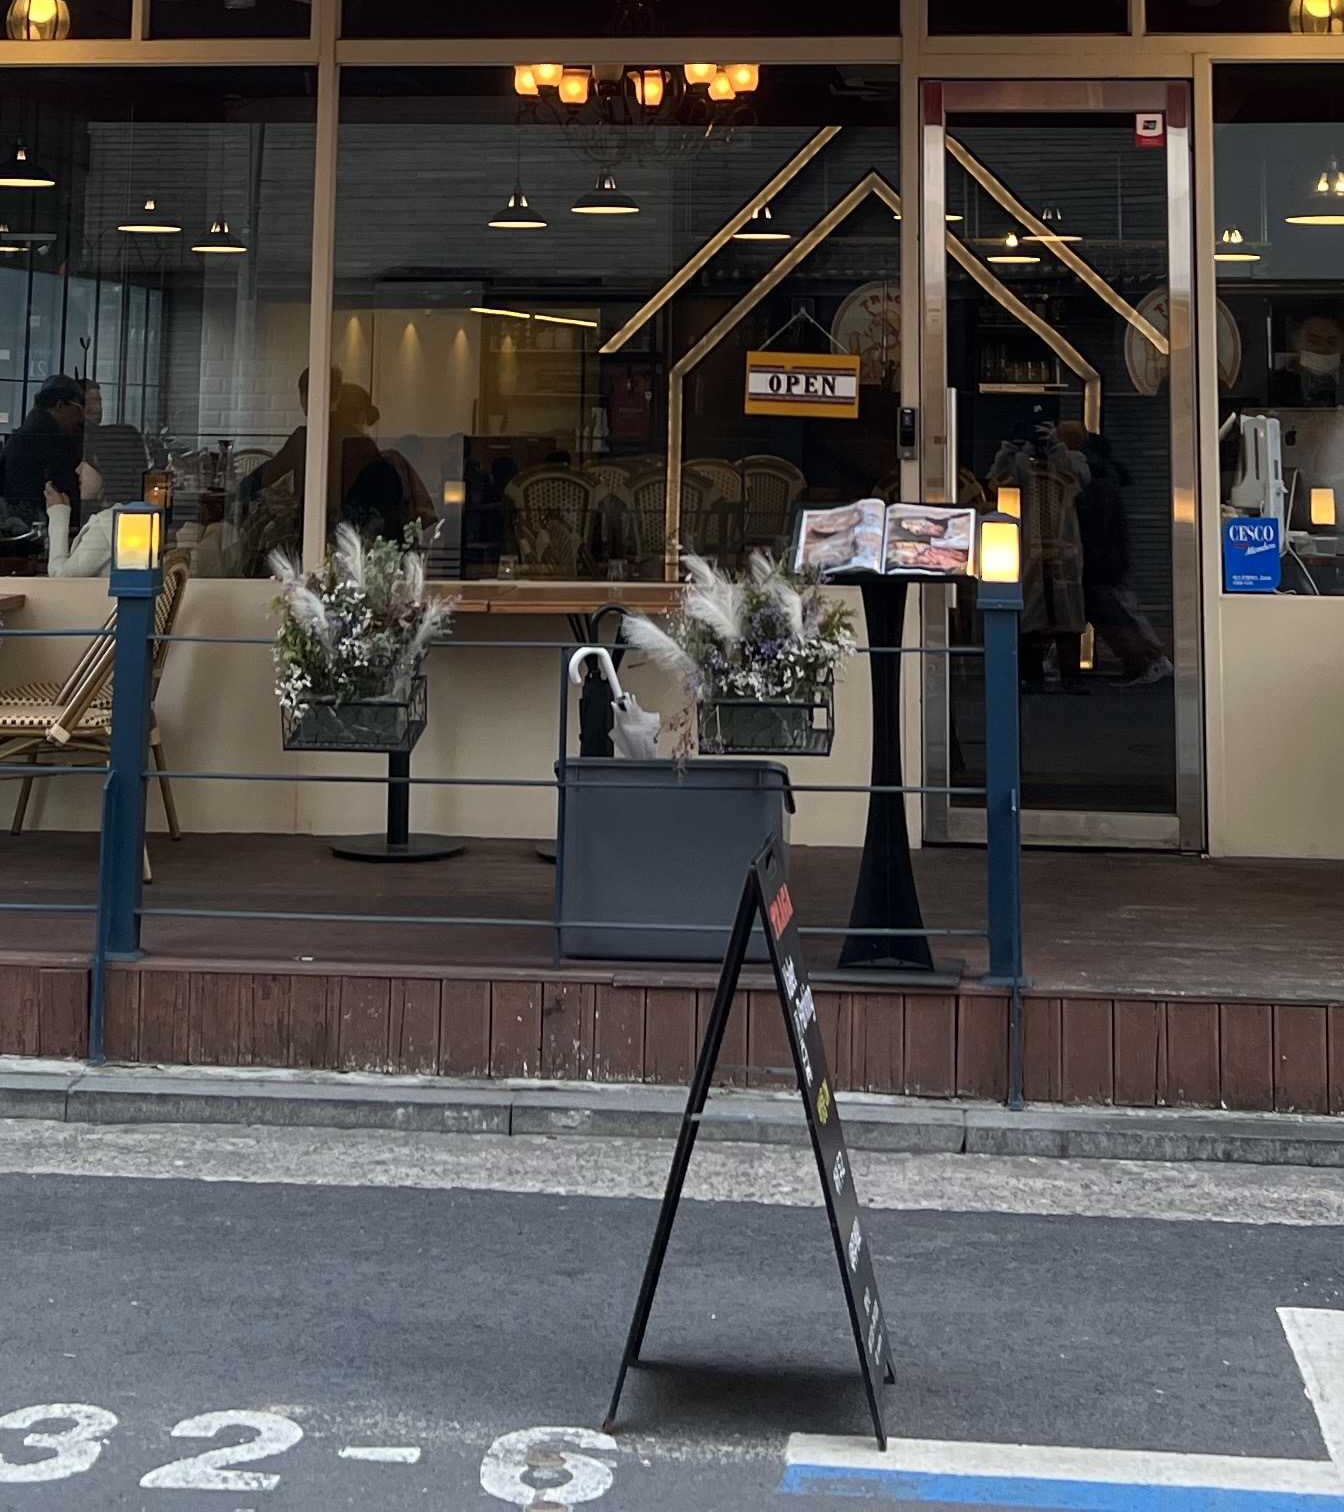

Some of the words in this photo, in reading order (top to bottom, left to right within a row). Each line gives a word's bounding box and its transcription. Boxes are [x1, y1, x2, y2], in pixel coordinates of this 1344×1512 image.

[860, 292, 900, 308] TRAG
[768, 374, 837, 396] OPEN
[1229, 525, 1274, 541] CESCO
